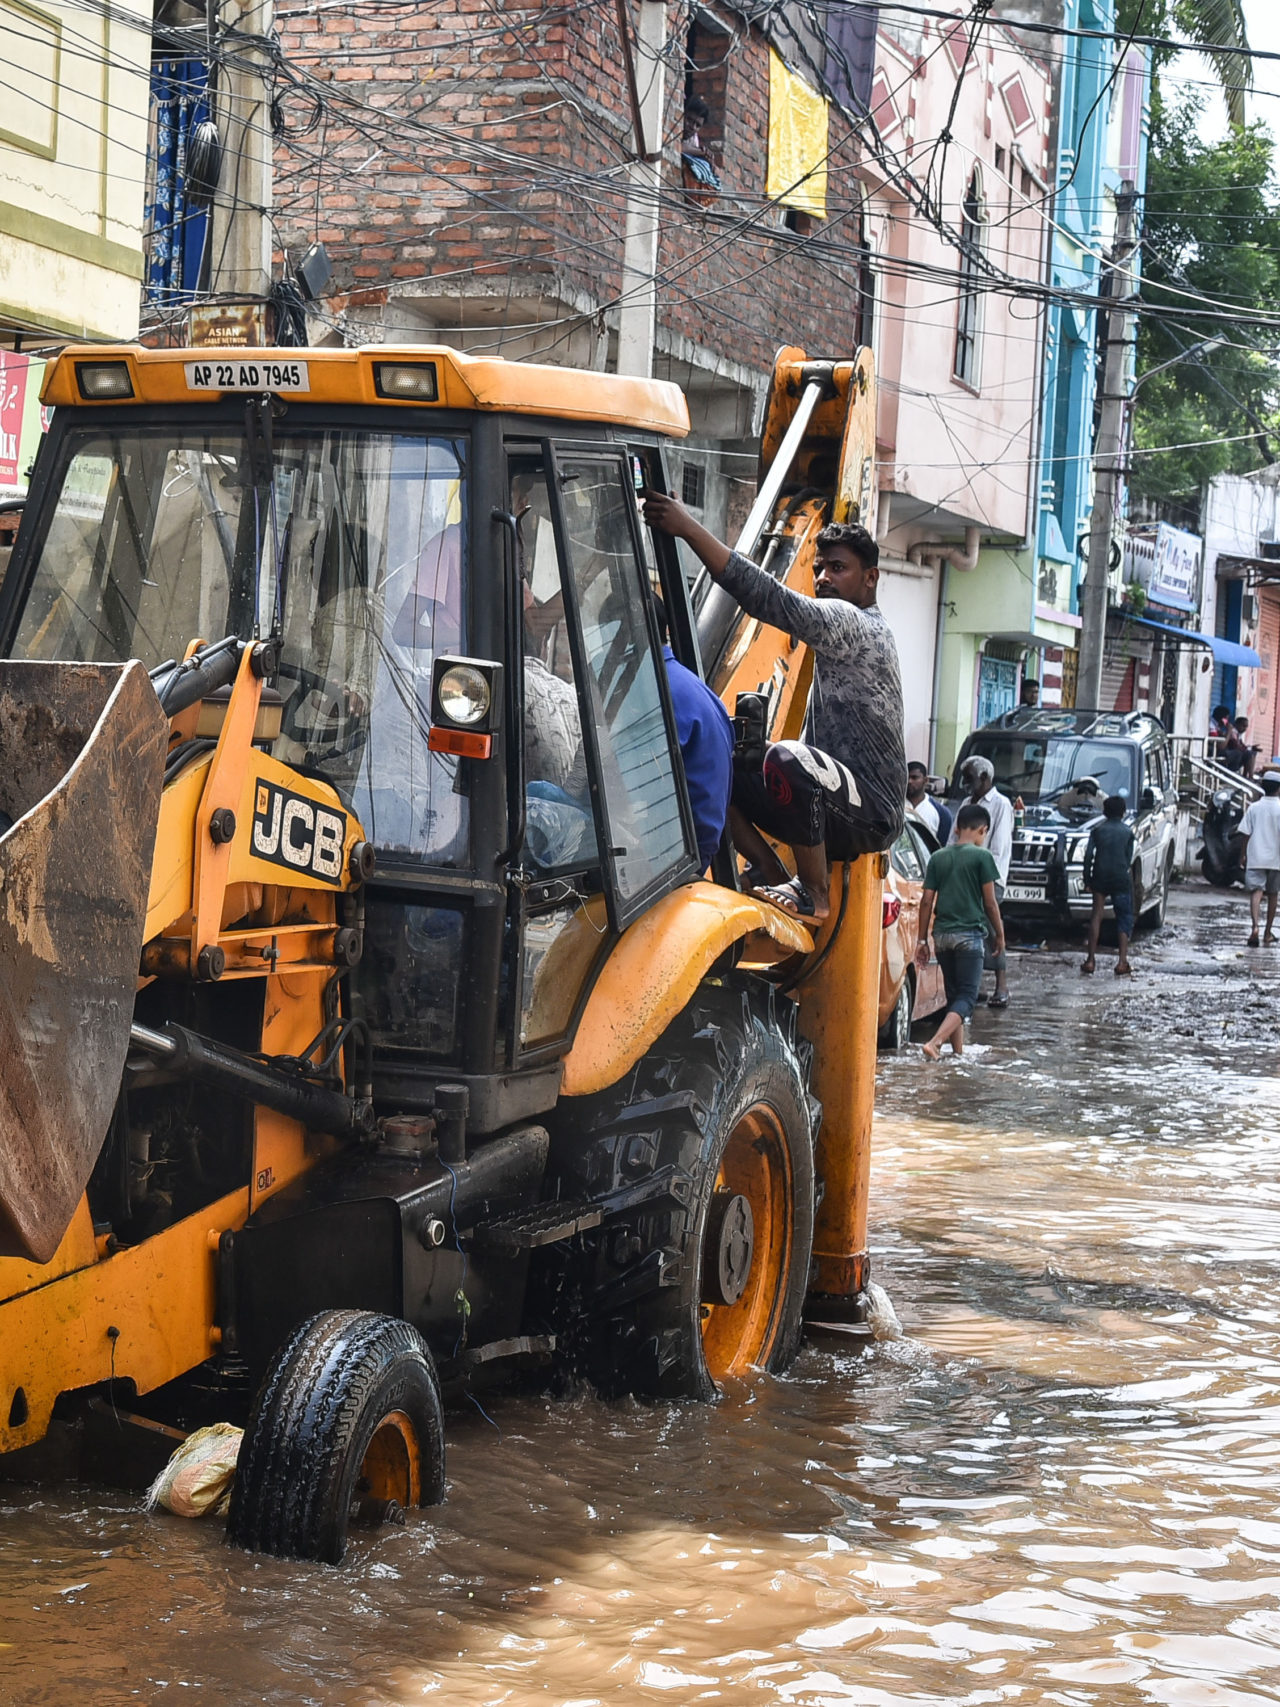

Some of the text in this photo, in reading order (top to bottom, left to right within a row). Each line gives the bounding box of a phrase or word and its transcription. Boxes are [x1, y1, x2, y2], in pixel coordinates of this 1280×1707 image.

[208, 328, 240, 337] ASIAN
[194, 365, 300, 386] AP 22 AD 7945
[253, 791, 344, 878] JCB
[1024, 889, 1042, 899] 999
